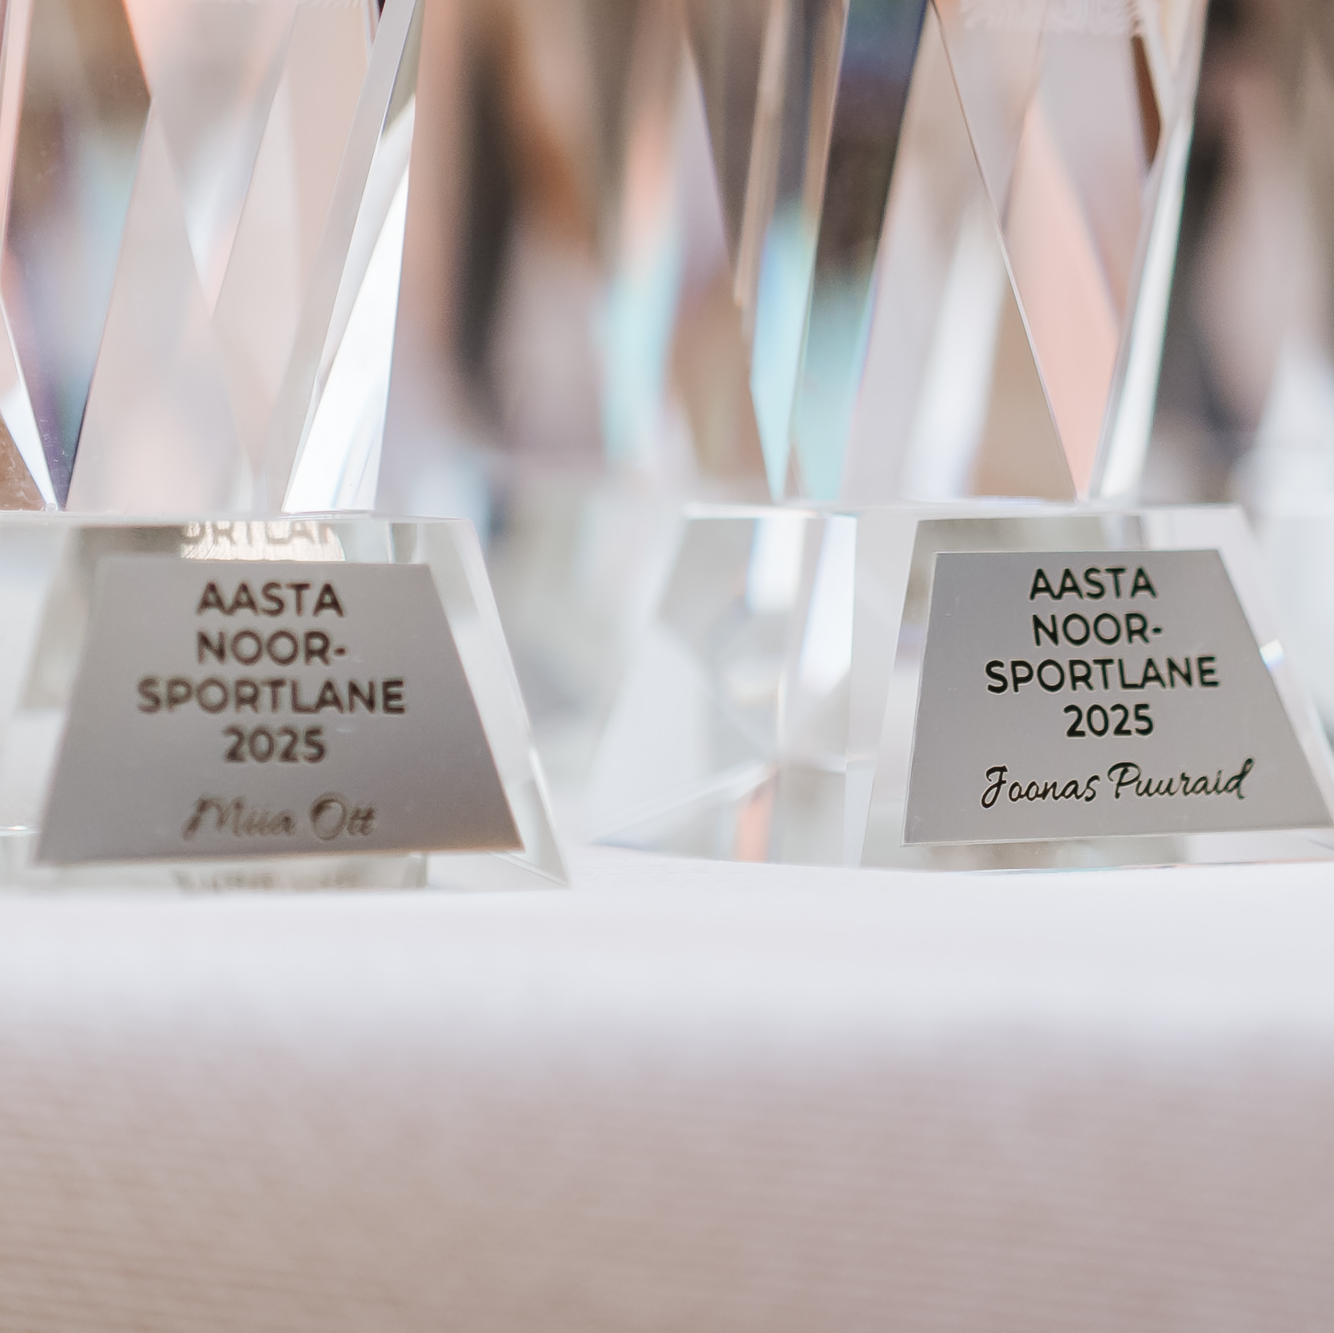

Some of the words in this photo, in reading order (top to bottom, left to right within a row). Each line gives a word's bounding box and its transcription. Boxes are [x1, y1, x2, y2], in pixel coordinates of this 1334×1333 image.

[195, 580, 344, 617] AASTA
[1028, 566, 1158, 601] AASTA
[196, 630, 347, 665] NOOR-
[1031, 611, 1164, 647] NOOR-
[984, 654, 1220, 694] SPORTLANE
[136, 677, 406, 714] SPORTLANE
[1063, 702, 1155, 738] 2025
[222, 726, 327, 763] 2025
[980, 764, 1100, 809] Joonas
[1107, 757, 1255, 801] Puuraid
[181, 792, 297, 841] Miia
[310, 791, 376, 841] Ott
